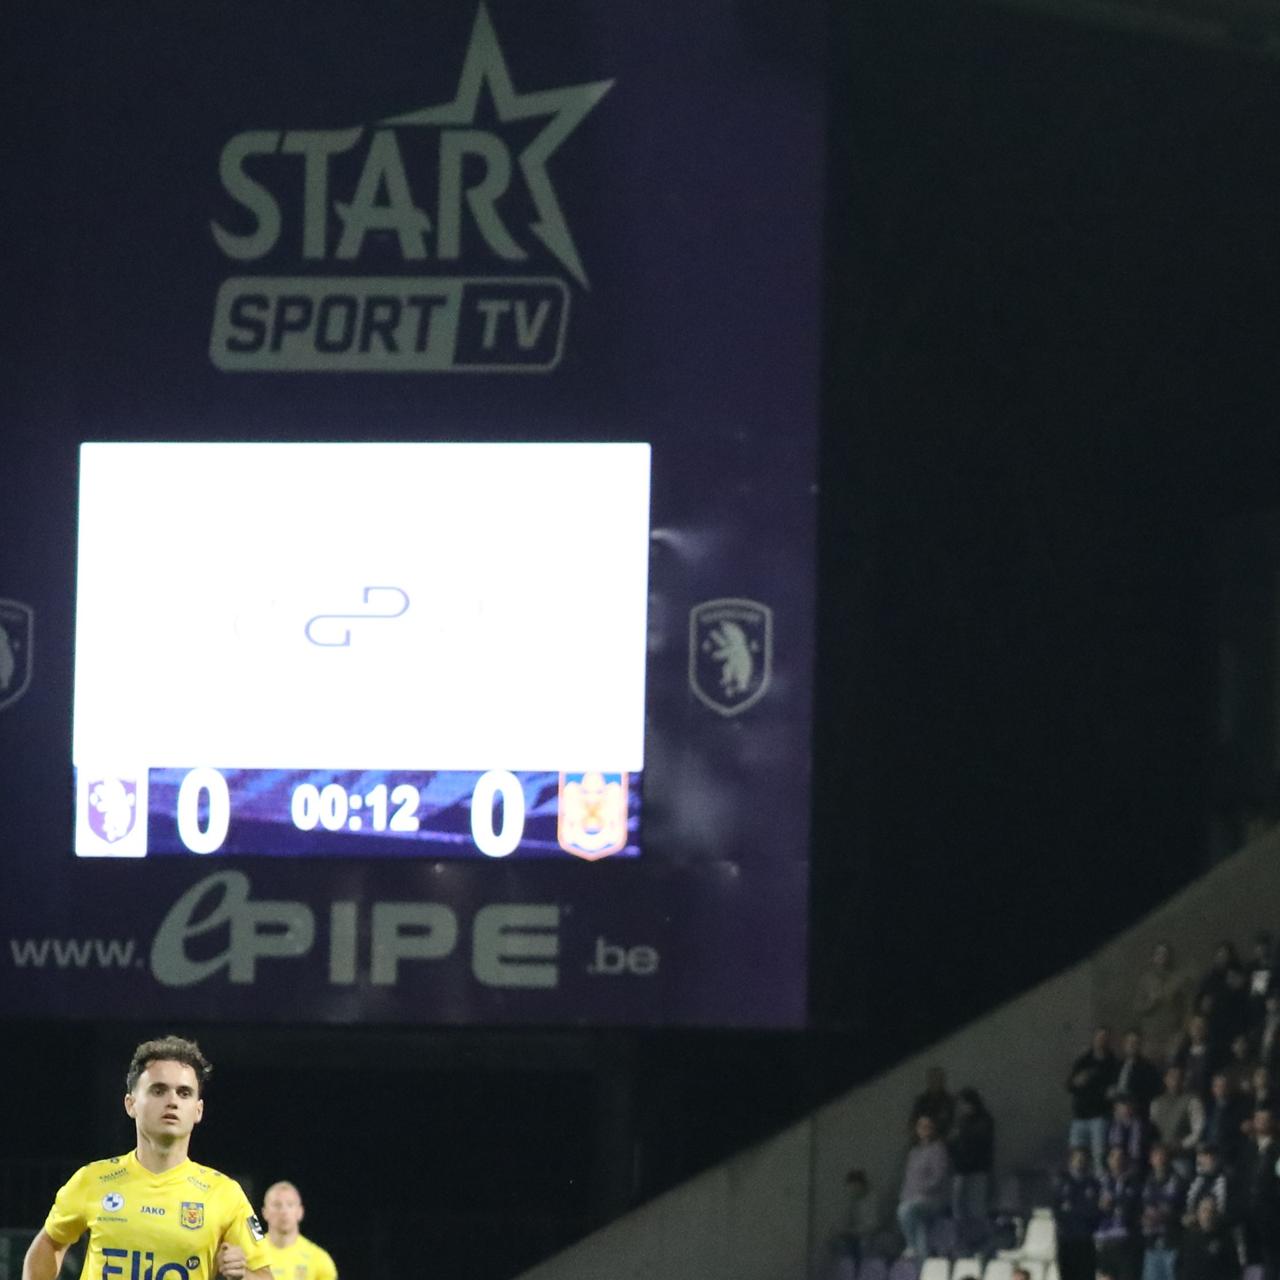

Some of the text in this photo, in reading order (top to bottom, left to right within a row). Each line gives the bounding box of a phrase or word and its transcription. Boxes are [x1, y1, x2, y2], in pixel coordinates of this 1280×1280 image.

[210, 126, 527, 262] STAR
[224, 291, 553, 358] SPORT TV
[176, 767, 230, 855] 0
[291, 785, 420, 832] 00:12
[471, 769, 525, 857] 0
[140, 1205, 166, 1216] JAKO
